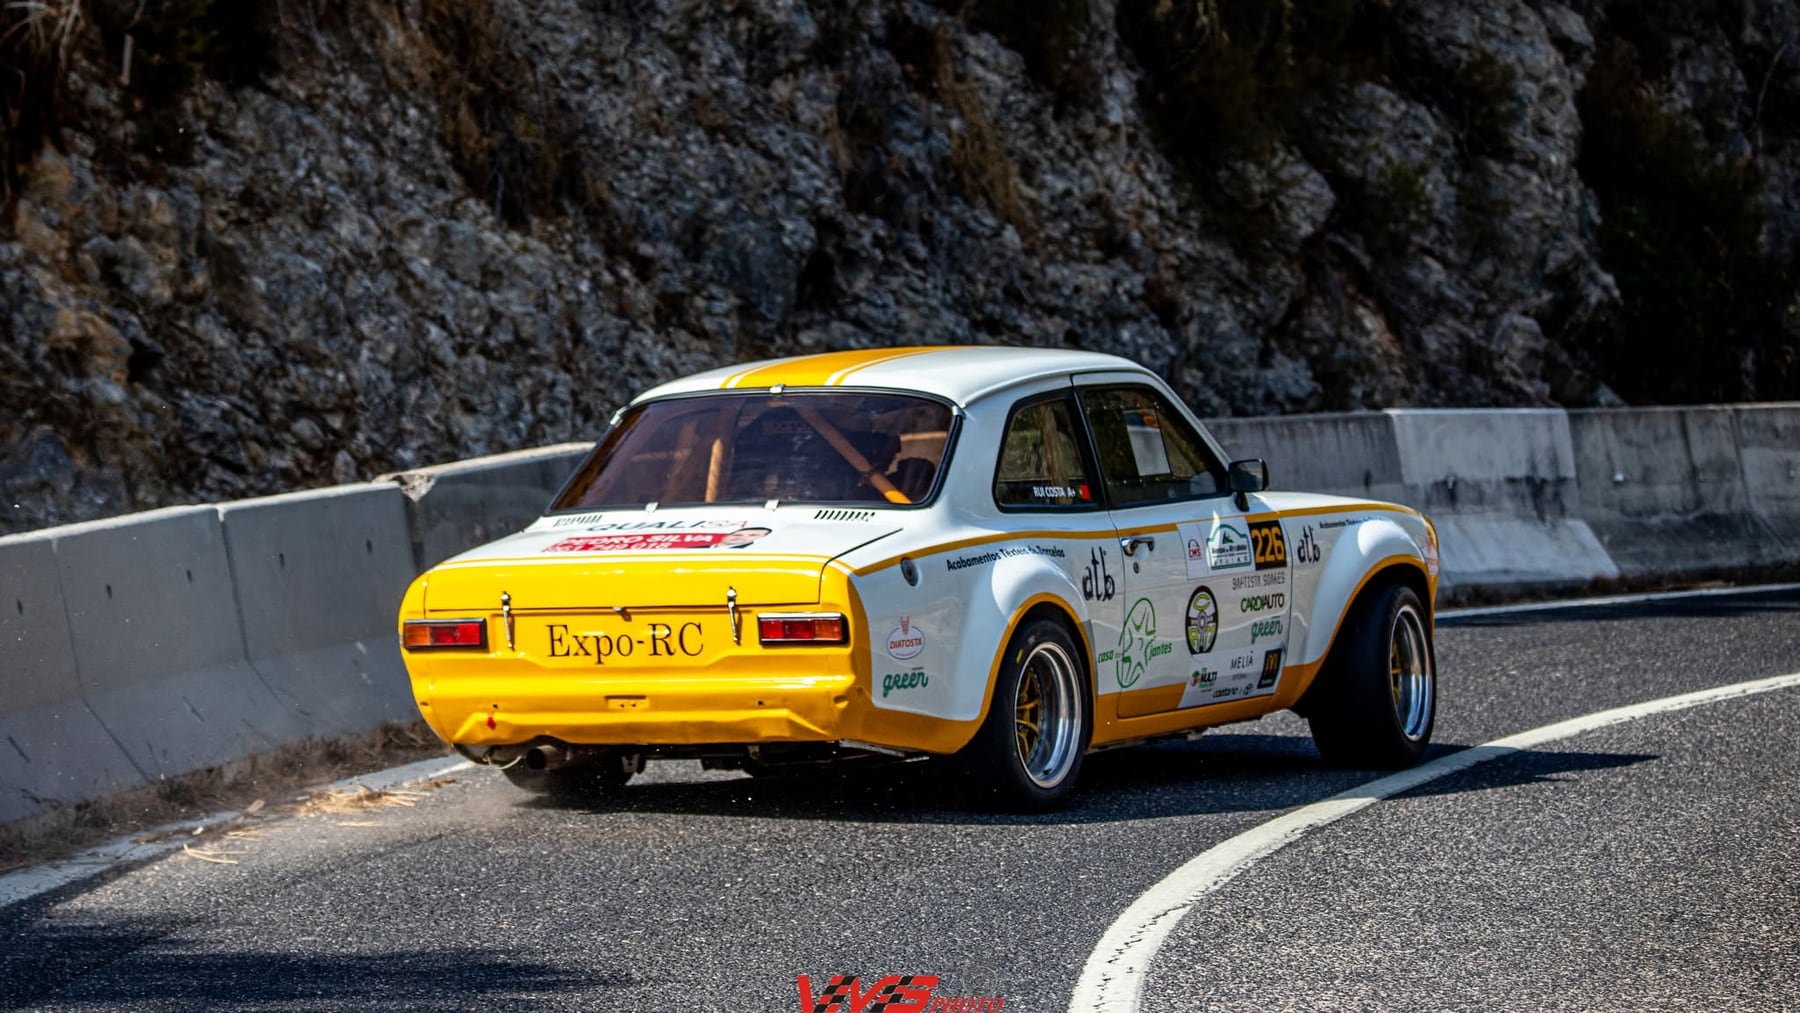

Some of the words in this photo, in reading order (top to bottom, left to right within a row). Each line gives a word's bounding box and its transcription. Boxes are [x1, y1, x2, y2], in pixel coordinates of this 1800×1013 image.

[1033, 486, 1046, 498] RUI
[1047, 486, 1065, 497] COSTA
[645, 533, 712, 543] SILVA
[1251, 527, 1285, 564] 226
[946, 551, 1001, 572] Acabamentos
[545, 621, 704, 665] Expo-RC
[1250, 619, 1284, 645] green
[882, 671, 929, 698] green
